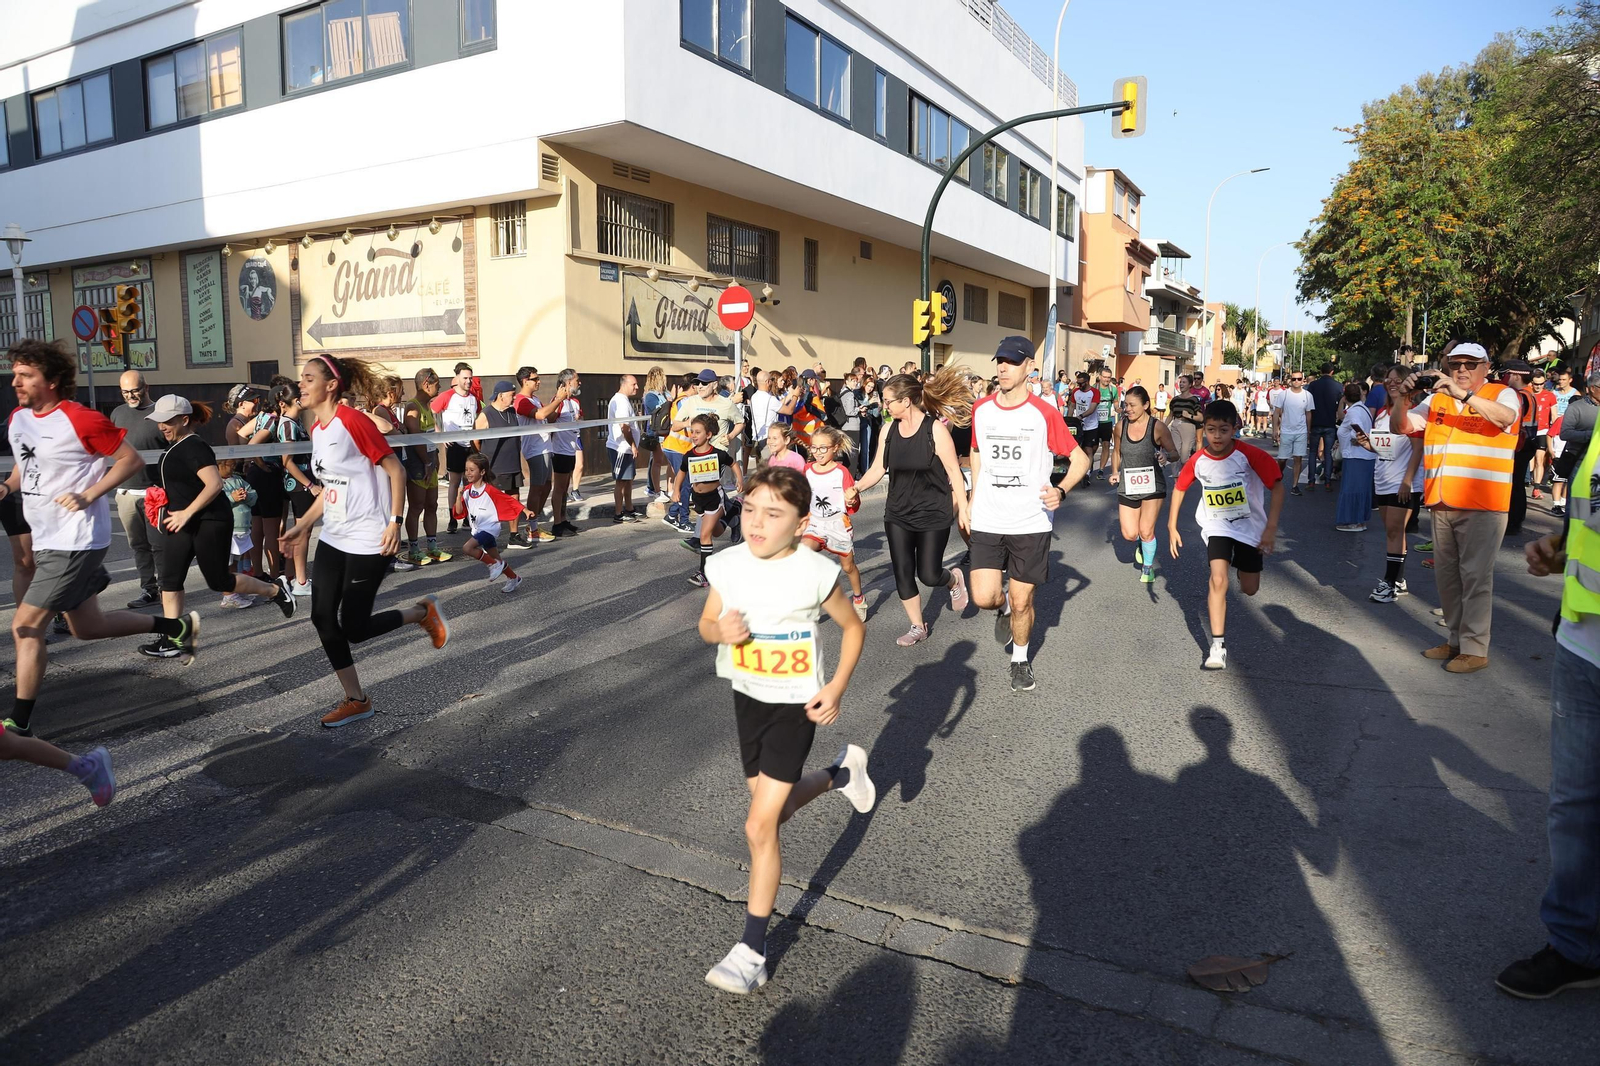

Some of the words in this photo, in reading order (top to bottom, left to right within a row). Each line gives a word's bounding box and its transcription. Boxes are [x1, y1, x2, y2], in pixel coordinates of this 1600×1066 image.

[193, 255, 214, 270] BURGERS
[196, 263, 210, 274] CHIPS
[196, 269, 211, 281] GAMES
[332, 240, 423, 318] Grand
[193, 280, 216, 295] FOOTBALL
[199, 277, 209, 286] FUN
[417, 277, 450, 297] CAFÉ
[198, 294, 212, 306] MUSIC
[199, 289, 210, 299] LOVE
[646, 288, 657, 301] LE
[444, 297, 460, 305] PALO
[199, 308, 211, 318] COME
[199, 313, 213, 325] INSIDE
[653, 294, 714, 340] Grand
[201, 323, 216, 335] ENJOY
[201, 339, 212, 349] LIFE
[1374, 436, 1391, 447] 712
[991, 444, 1022, 460] 356
[691, 461, 717, 474] 1111
[1130, 474, 1150, 485] 603
[1206, 490, 1245, 506] 1064
[734, 644, 810, 674] 1128
